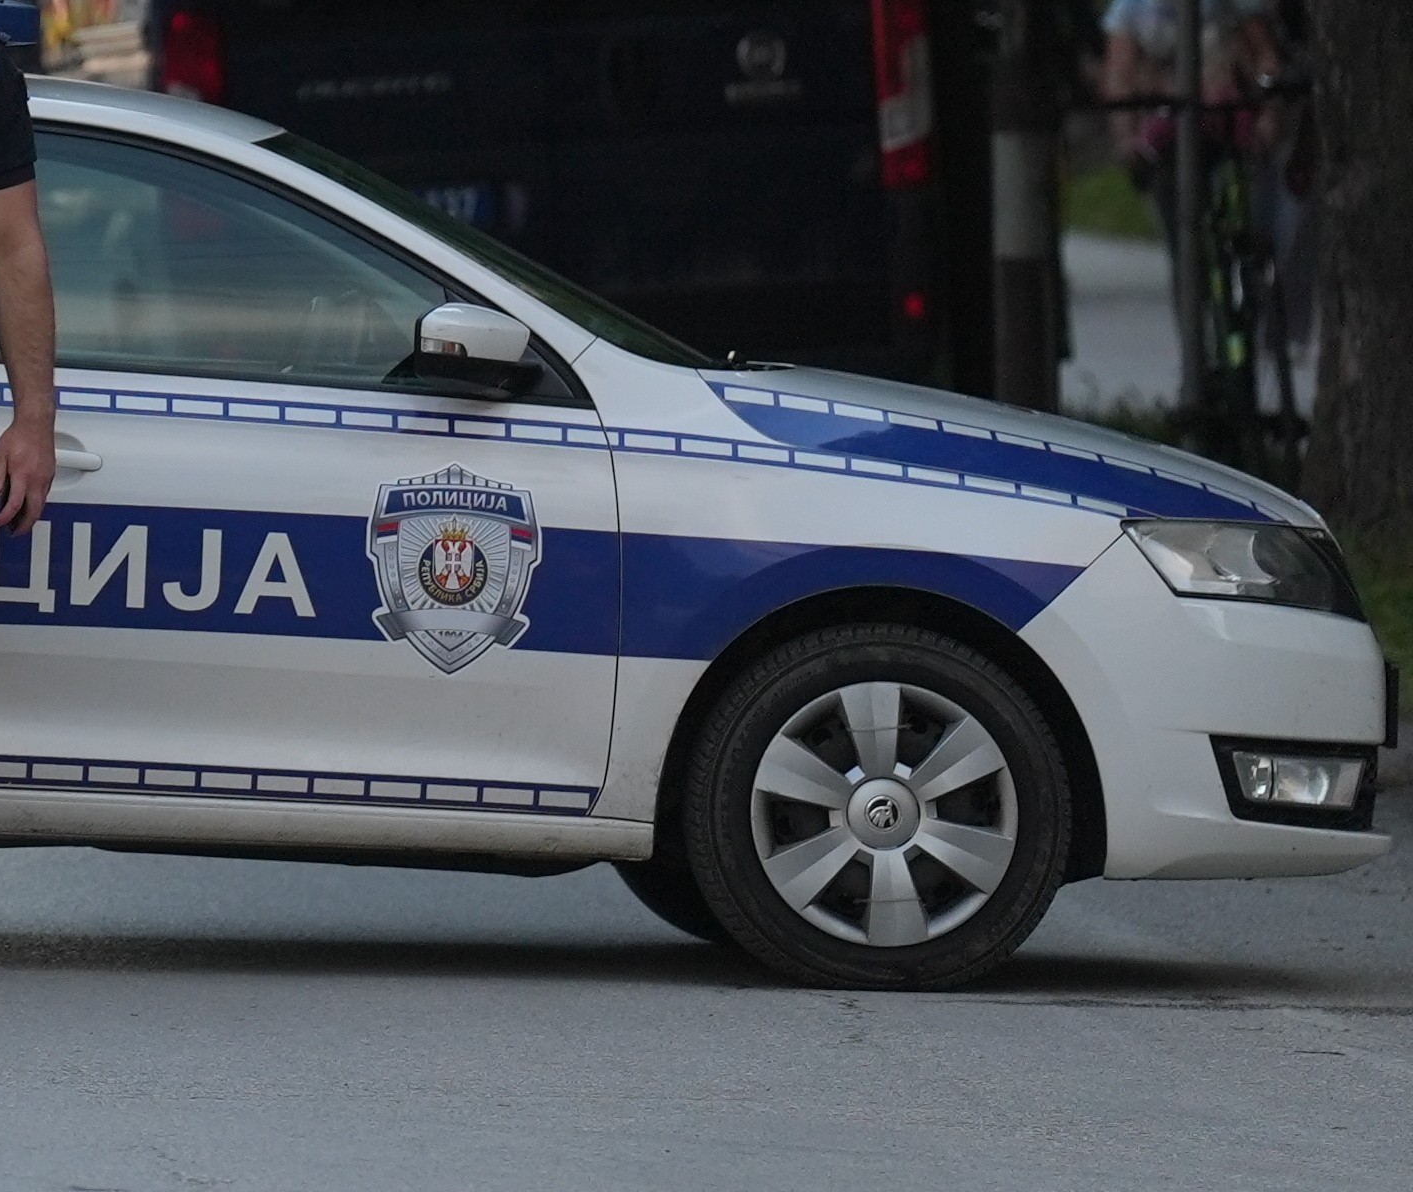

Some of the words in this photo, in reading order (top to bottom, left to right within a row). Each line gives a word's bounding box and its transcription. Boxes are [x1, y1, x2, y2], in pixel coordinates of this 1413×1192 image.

[402, 490, 508, 512] ПОЛИЦИЈА
[421, 559, 463, 602] РЕПУБЛИКА
[464, 559, 485, 598] СРБИЈА
